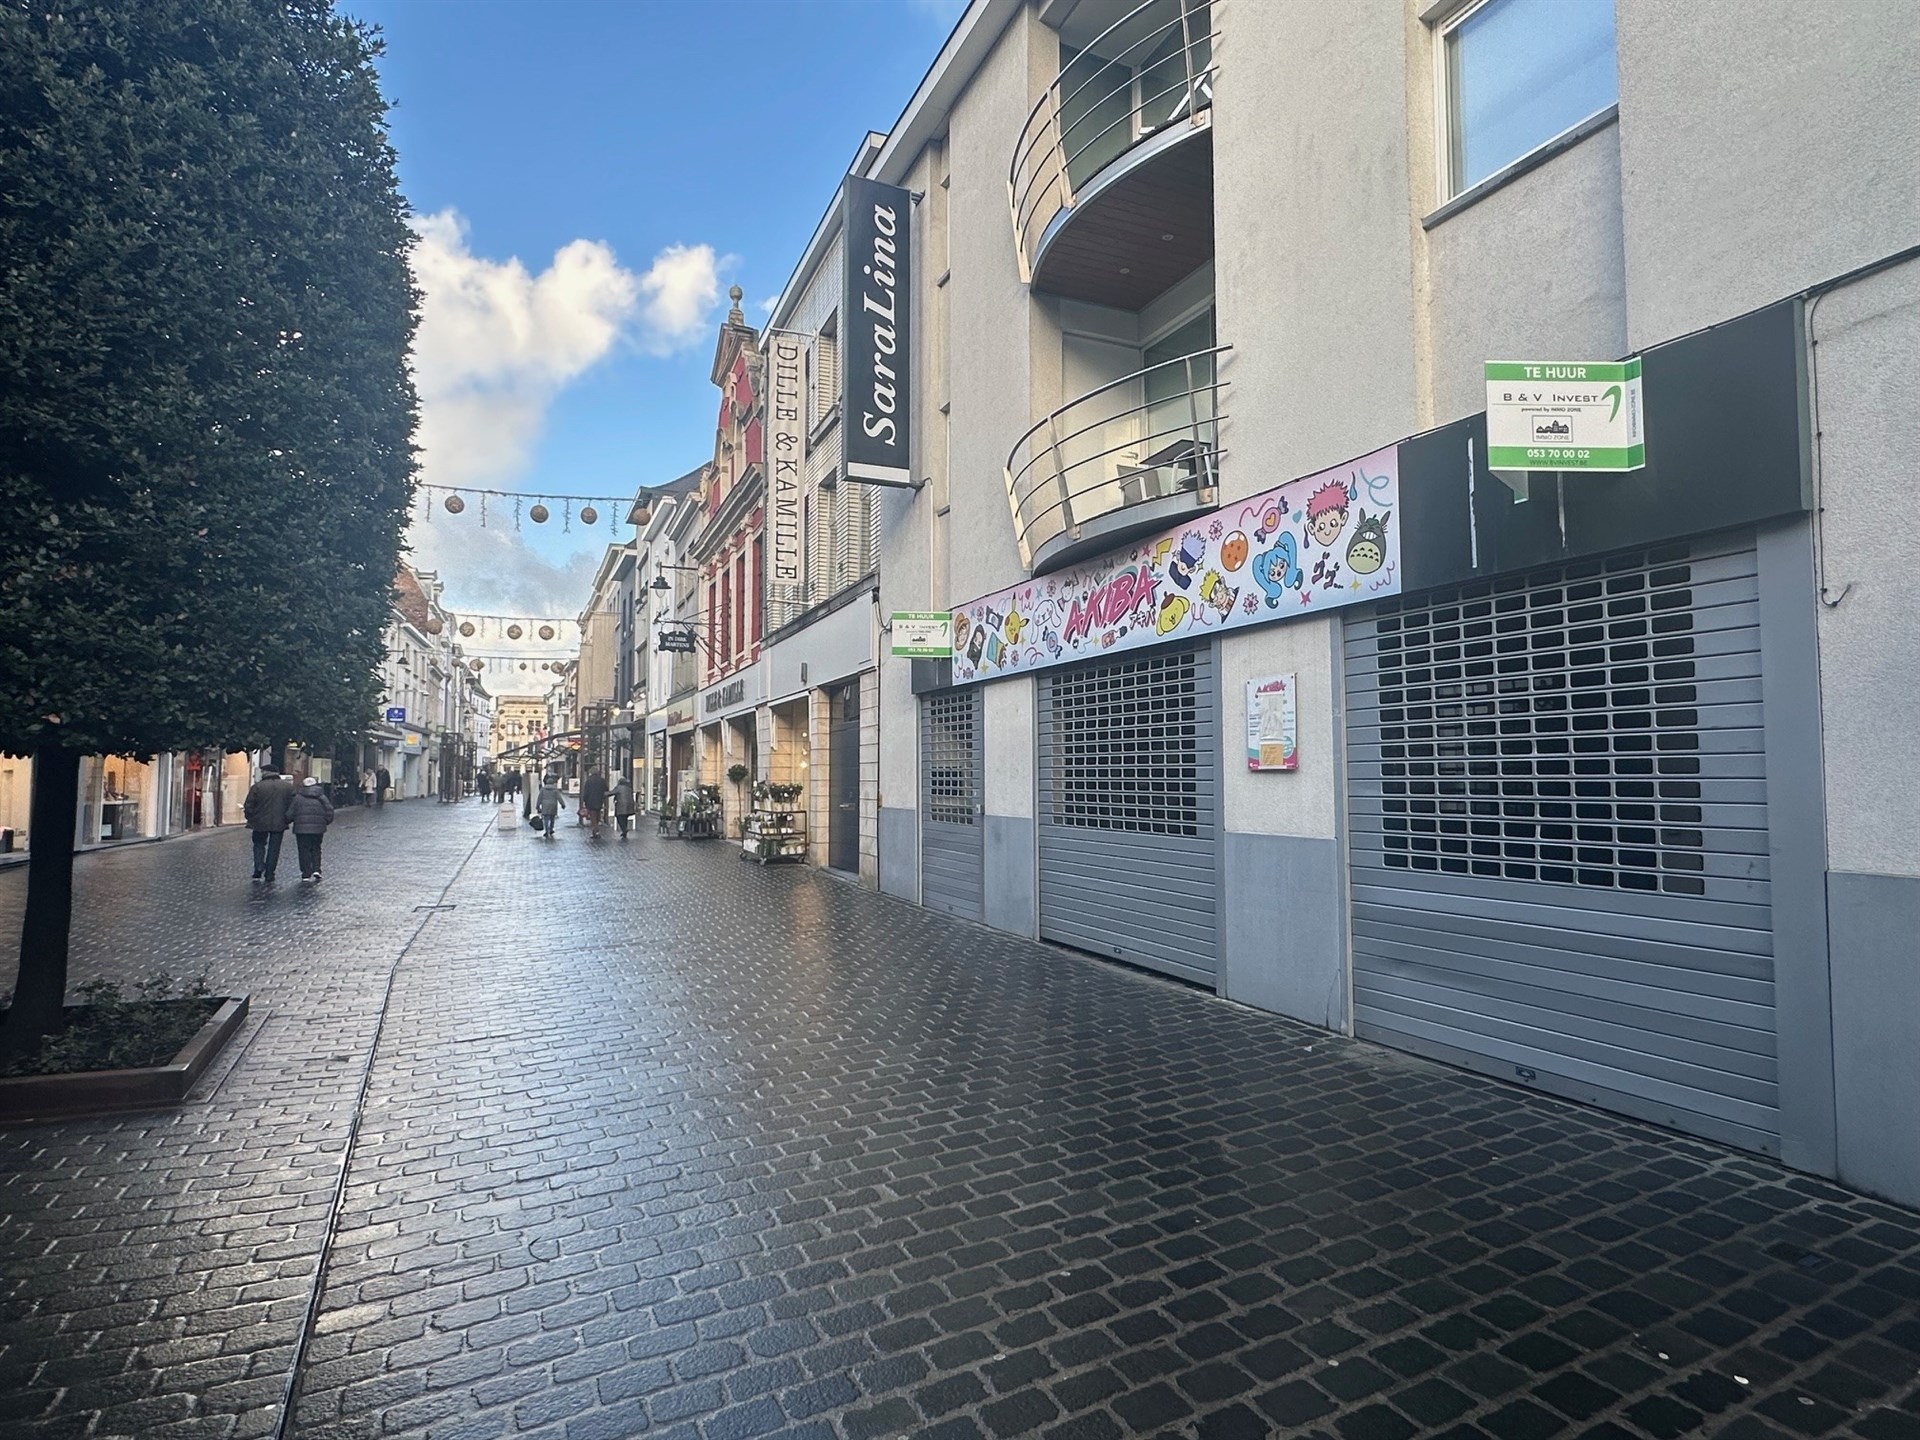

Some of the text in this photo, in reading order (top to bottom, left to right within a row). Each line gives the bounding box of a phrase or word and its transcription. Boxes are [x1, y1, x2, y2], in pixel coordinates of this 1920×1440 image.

[863, 203, 897, 446] SaraLina
[1524, 367, 1587, 379] TE HUUR
[1503, 393, 1512, 401] B
[1518, 393, 1528, 402] &
[1533, 393, 1542, 402] V
[775, 342, 799, 580] DILLE & KAMILLE
[1527, 449, 1590, 459] 053 70 00 02
[1063, 564, 1162, 643] AKIBA
